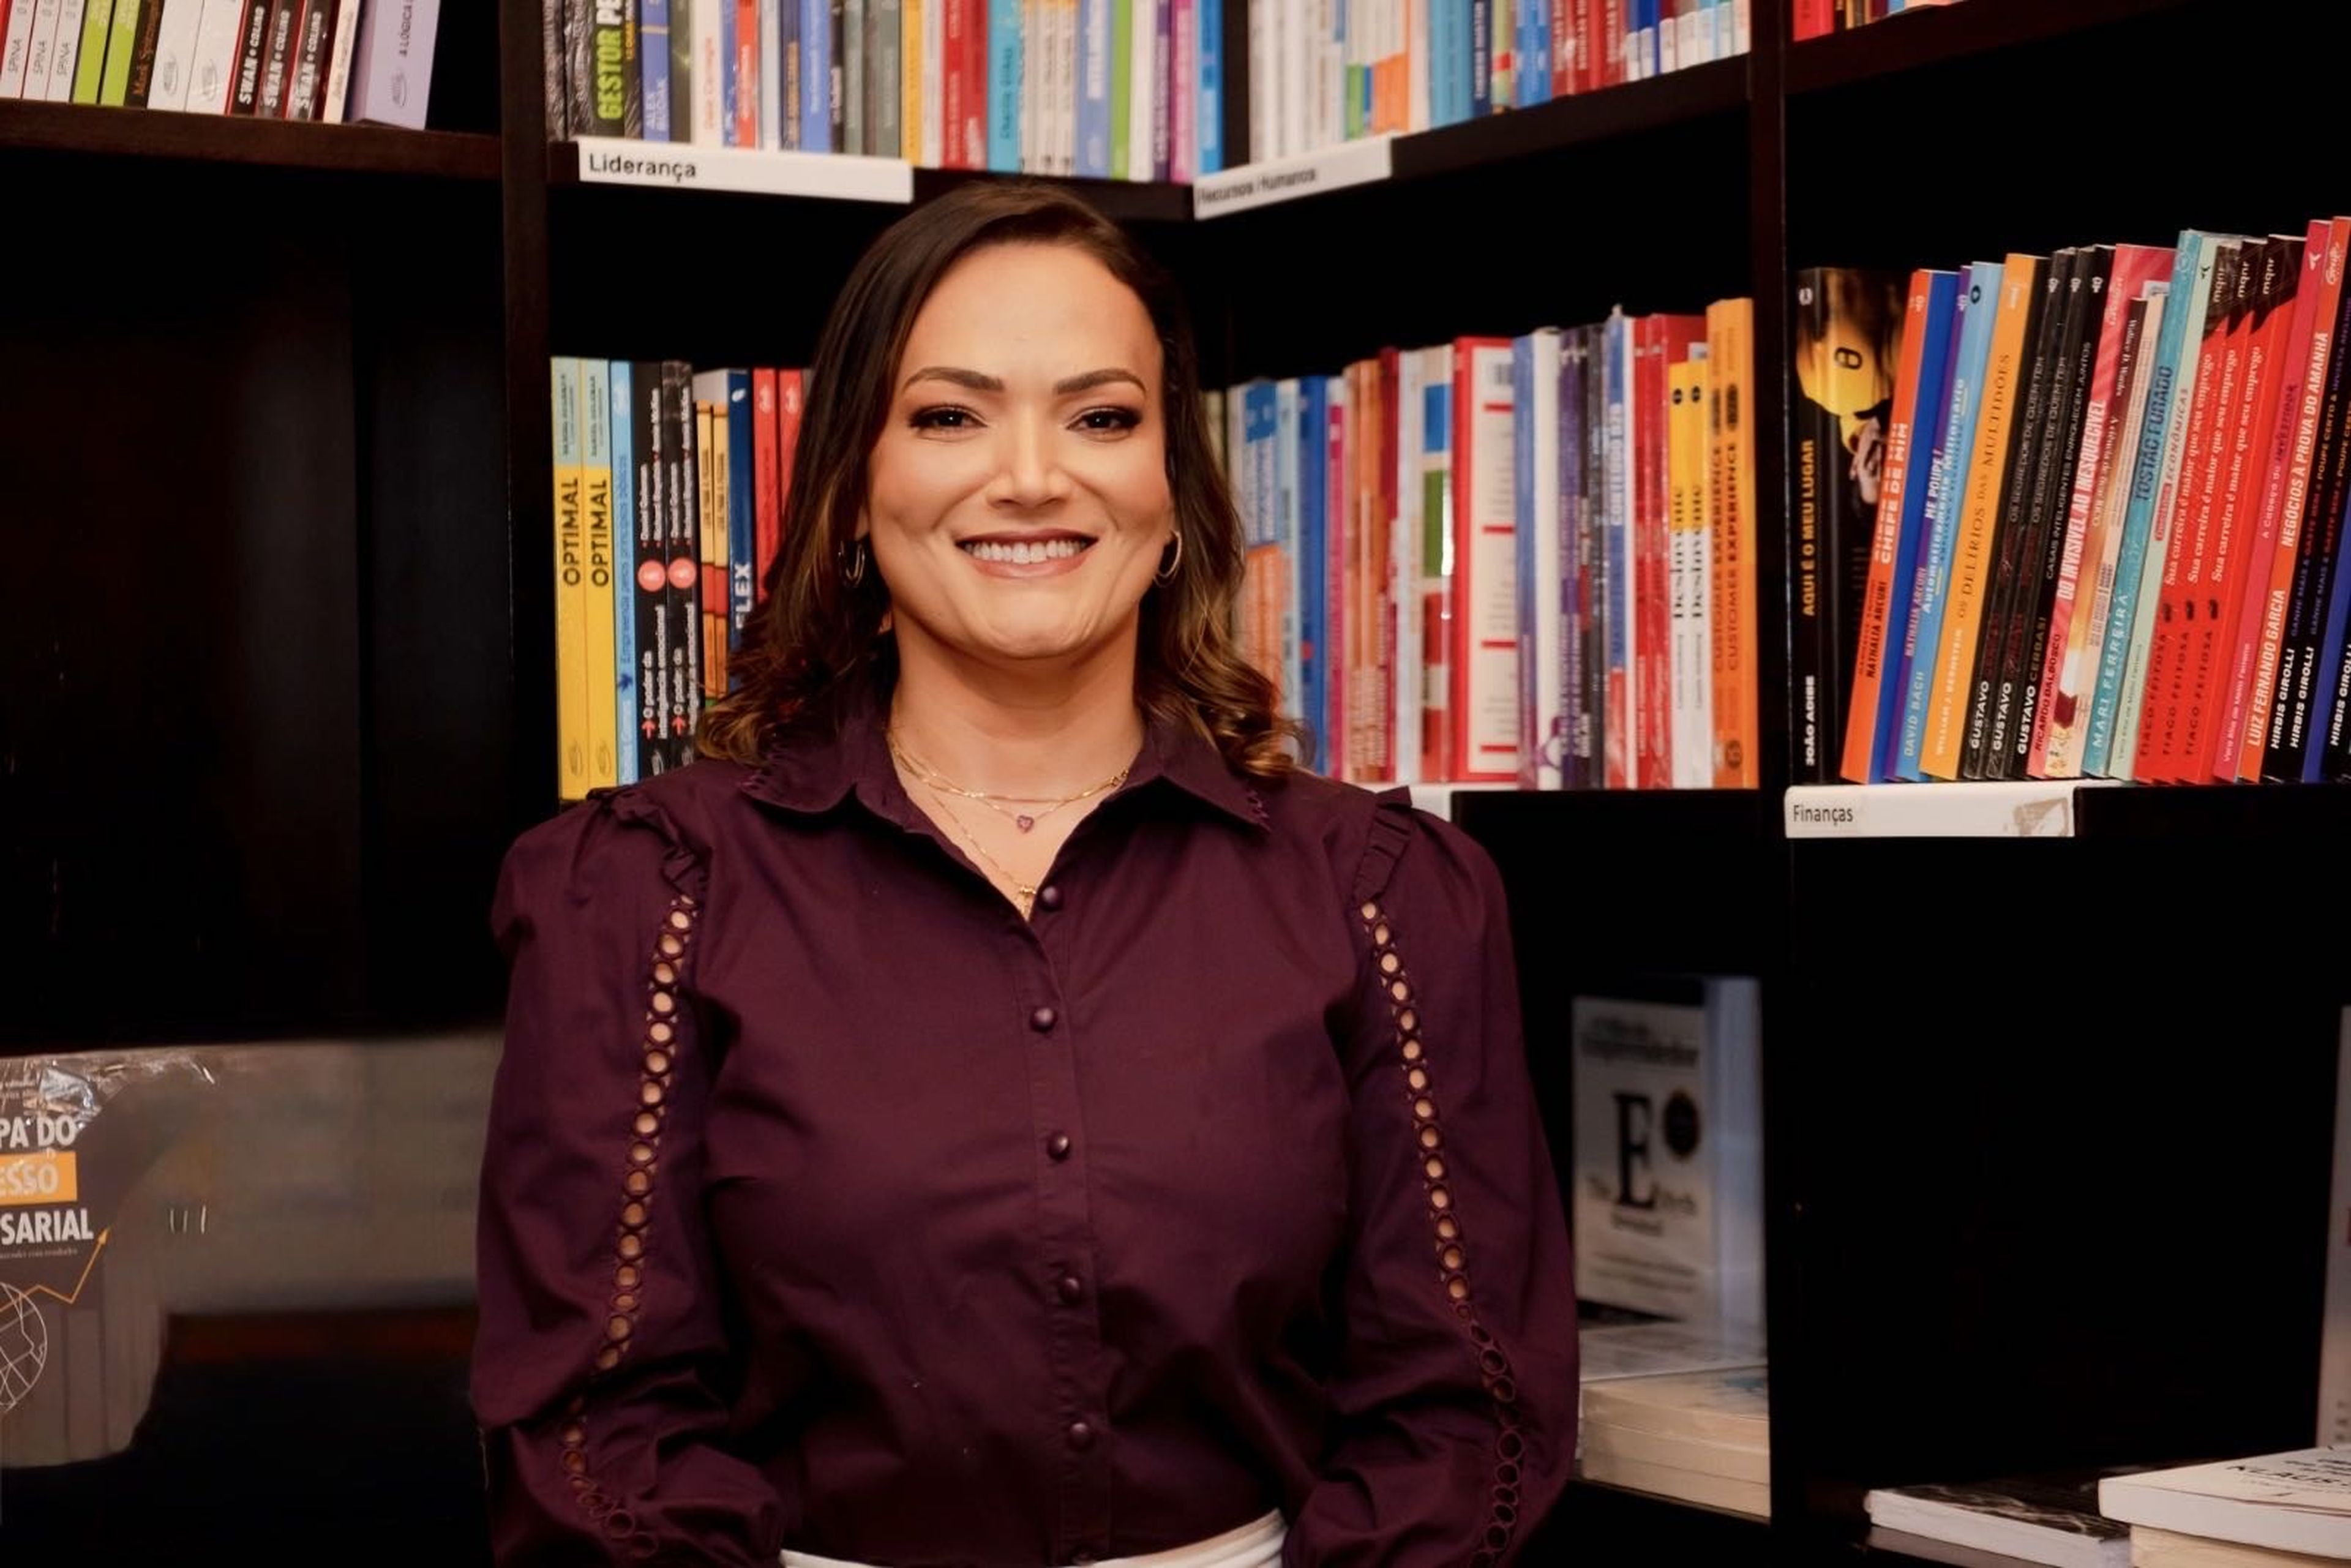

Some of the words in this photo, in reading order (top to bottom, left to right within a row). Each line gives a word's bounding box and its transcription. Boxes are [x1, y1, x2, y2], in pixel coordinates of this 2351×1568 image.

[238, 56, 258, 105] SWAN
[263, 60, 283, 108] SWAN
[597, 29, 623, 119] GESTOR
[590, 153, 697, 183] Liderança
[2211, 265, 2225, 302] mqnr
[2236, 261, 2251, 298] mqnr
[2260, 257, 2275, 294] mqnr
[2077, 342, 2092, 387] JUNTOS
[2195, 353, 2214, 408] emprego
[2219, 349, 2238, 404] emprego
[2242, 347, 2262, 402] emprego
[2308, 332, 2329, 394] AMANHÃ
[2025, 383, 2041, 419] QUEM
[2048, 383, 2064, 419] QUEM
[2147, 366, 2173, 435] FURADO
[2192, 410, 2203, 432] seu
[2216, 407, 2227, 427] seu
[2240, 403, 2251, 426] seu
[2303, 394, 2318, 415] DO
[2323, 403, 2336, 441] CERTO
[1891, 422, 1909, 462] MIM
[2023, 421, 2034, 437] DE
[2064, 387, 2082, 460] ENRIQUECEM
[2164, 388, 2189, 482] ECONÔMICAS
[2188, 433, 2202, 457] que
[2211, 429, 2224, 454] que
[2235, 427, 2248, 451] que
[2296, 418, 2314, 463] PROVA
[1801, 440, 1815, 498] LUGAR
[1889, 467, 1903, 494] DE
[1977, 473, 1987, 500] DAS
[2101, 461, 2112, 475] de
[2181, 457, 2197, 497] maior
[2203, 455, 2219, 494] maior
[2227, 452, 2243, 492] maior
[1727, 443, 1738, 562] EXPERIENCE
[2052, 462, 2072, 537] INTELIGENTES
[2201, 495, 2212, 504] é
[2224, 493, 2237, 502] é
[2279, 479, 2304, 547] NEGÓCIOS
[561, 479, 580, 585] OPTIMAL
[590, 480, 609, 587] OPTIMAL
[1802, 502, 1815, 539] MEU
[1880, 498, 1899, 565] CHEFE
[2171, 508, 2186, 559] carreira
[2194, 506, 2210, 557] carreira
[2218, 503, 2235, 555] carreira
[1801, 560, 1815, 570] É
[1802, 544, 1814, 556] O
[2046, 539, 2059, 580] CASAIS
[2057, 580, 2076, 600] DO
[2071, 493, 2090, 513] AO
[2165, 561, 2178, 585] Sua
[2188, 558, 2200, 583] Sua
[2211, 557, 2225, 582] Sua
[1802, 574, 1816, 616] AQUI
[2266, 590, 2286, 640] GARCIA
[654, 604, 666, 669] emocional
[684, 602, 696, 666] emocional
[1727, 572, 1738, 671] CUSTOMER
[1865, 625, 1881, 678] NATHALIA
[1873, 581, 1887, 622] ARCURI
[1904, 607, 1921, 657] NATHALIA
[642, 651, 653, 669] da
[672, 648, 683, 665] da
[2041, 634, 2061, 698] DALBOSCO
[2253, 641, 2277, 713] FERNANDO
[642, 669, 654, 706] poder
[672, 667, 685, 703] poder
[1805, 675, 1815, 722] ADIBE
[1910, 670, 1924, 710] BACH
[1936, 707, 1951, 755] WILLIAM
[1944, 628, 1963, 693] BERNSTEIN
[2017, 685, 2036, 755] GUSTAVO
[2029, 616, 2047, 683] CERBASI
[2139, 706, 2154, 757] TIAGO
[2148, 633, 2167, 700] FEITOSA
[2161, 706, 2177, 756] TIAGO
[2171, 632, 2190, 700] FEITOSA
[2185, 706, 2201, 756] TIAGO
[2194, 630, 2213, 700] FEITOSA
[2270, 702, 2286, 748] HIRBIS
[2278, 648, 2295, 700] GIROLLI
[2290, 702, 2306, 748] HIRBIS
[2298, 646, 2314, 699] GIROLLI
[643, 707, 653, 719] O
[673, 703, 684, 715] O
[1971, 681, 1989, 749] GUSTAVO
[1993, 681, 2012, 751] GUSTAVO
[2034, 699, 2049, 752] RICARDO
[2091, 698, 2111, 748] MARI
[2247, 715, 2264, 746] LUIZ
[2330, 700, 2345, 746] HIRBIS
[1804, 724, 1815, 767] JOÃO
[1903, 715, 1918, 756] DAVID
[1793, 804, 1854, 827] Finanças
[37, 1114, 77, 1147] DO
[1613, 1090, 1658, 1211] E
[0, 1207, 94, 1246] SARIAL
